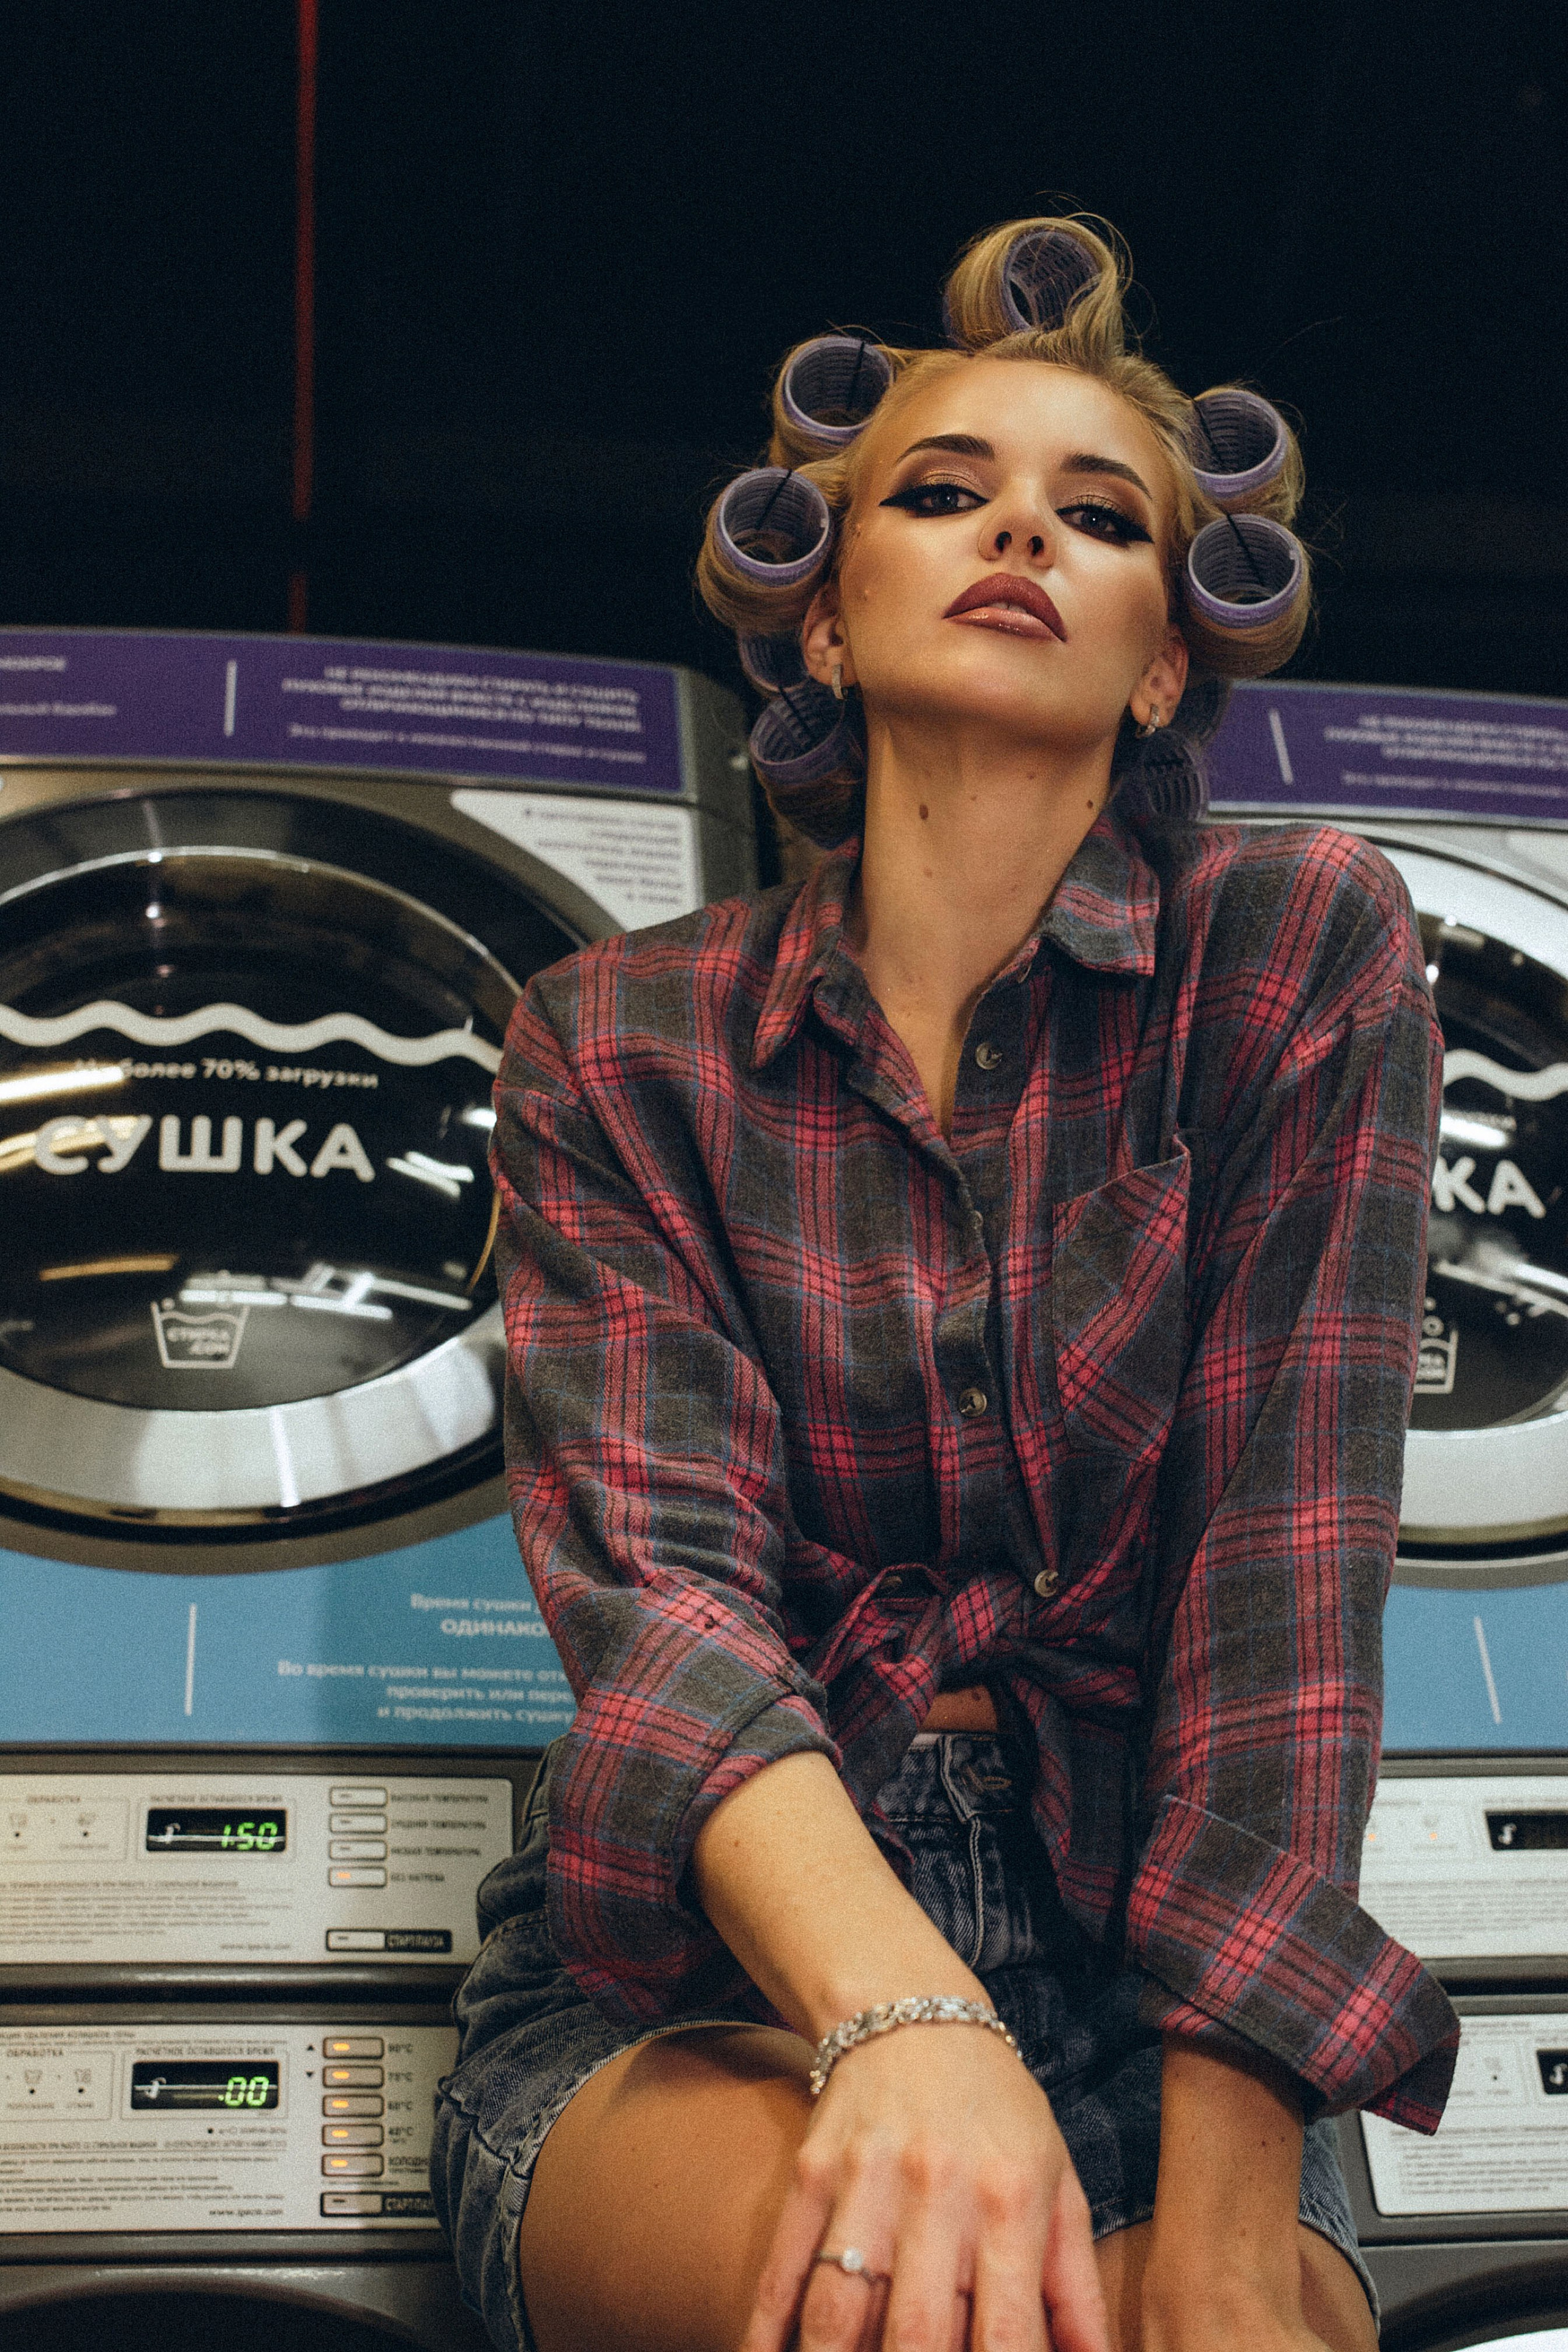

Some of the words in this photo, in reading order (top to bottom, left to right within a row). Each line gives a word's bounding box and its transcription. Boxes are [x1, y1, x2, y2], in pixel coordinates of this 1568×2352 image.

[201, 1058, 260, 1080] 70%
[265, 1065, 379, 1089] загрузки
[34, 1114, 375, 1183] СУШКА
